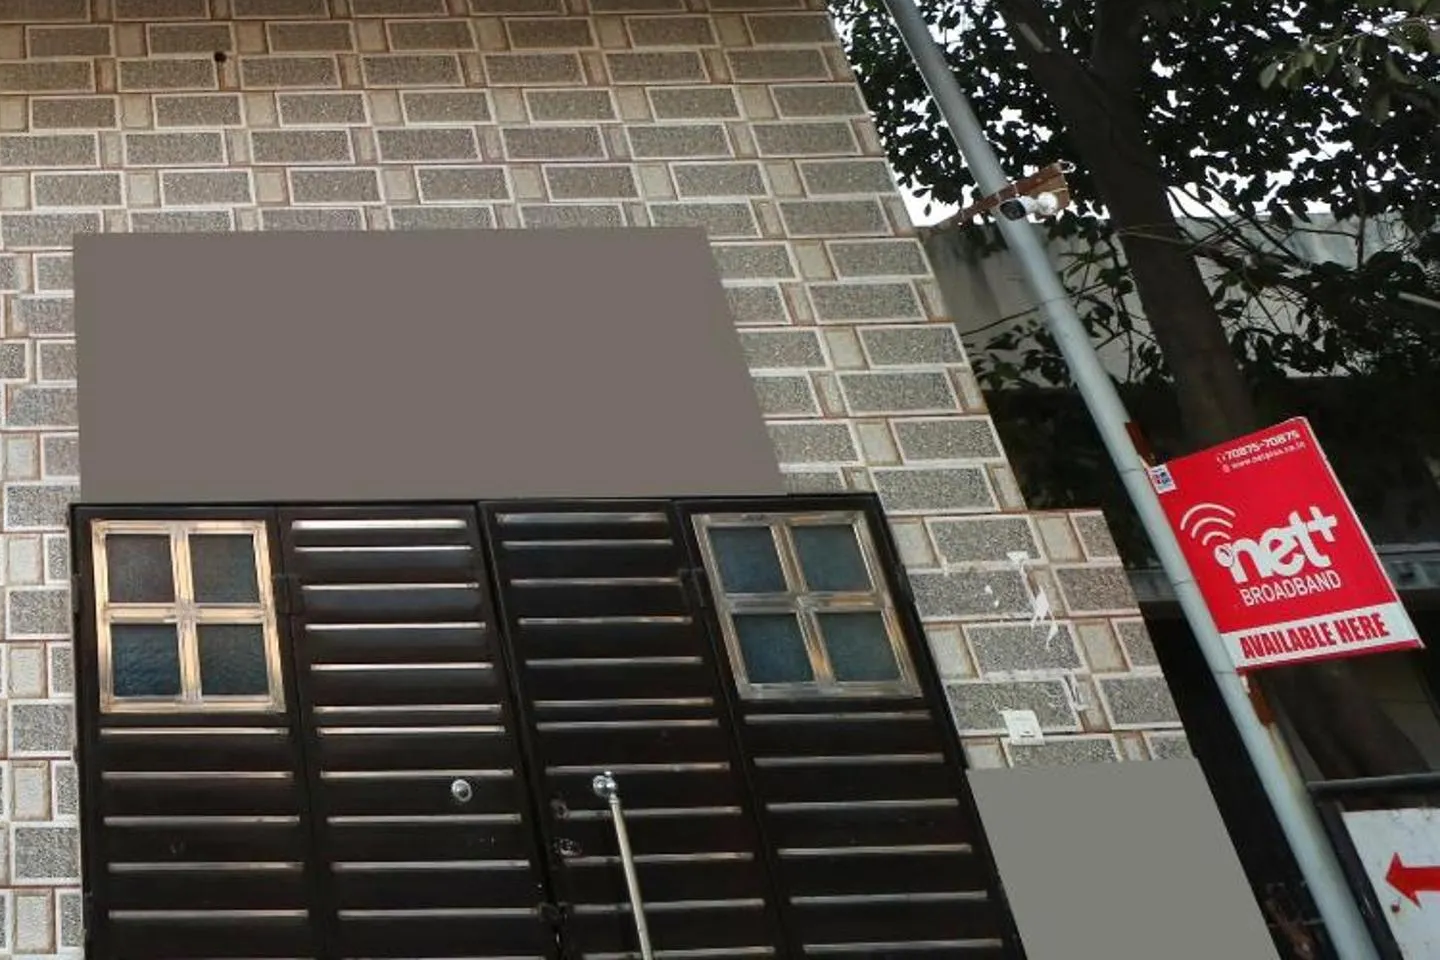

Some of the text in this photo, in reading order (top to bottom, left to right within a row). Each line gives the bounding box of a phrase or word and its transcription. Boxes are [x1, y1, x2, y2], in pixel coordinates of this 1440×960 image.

[1240, 570, 1342, 607] BROADBAND
[1239, 613, 1390, 659] AVAILABLE HERE
